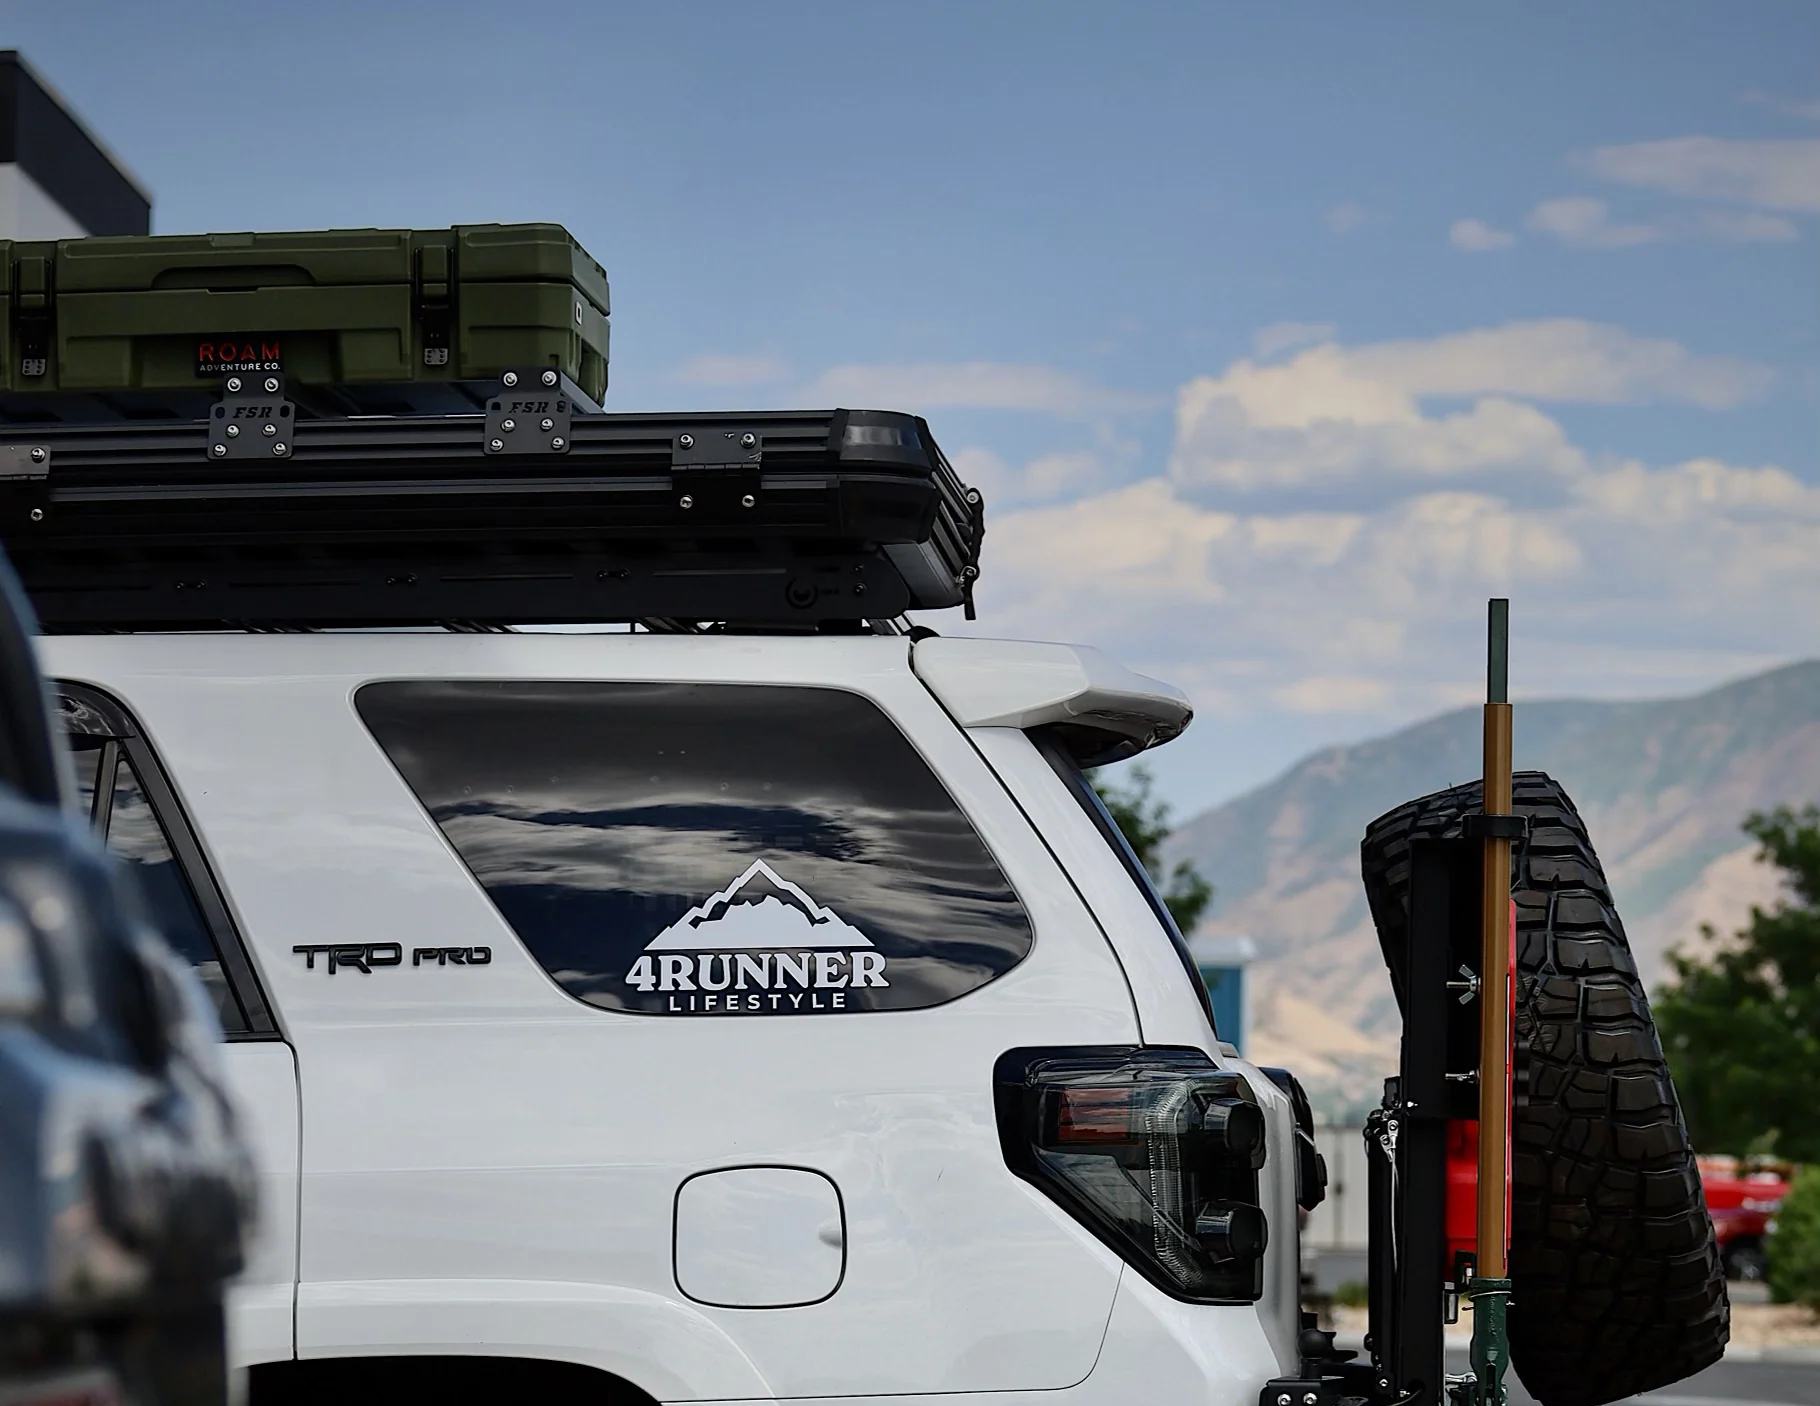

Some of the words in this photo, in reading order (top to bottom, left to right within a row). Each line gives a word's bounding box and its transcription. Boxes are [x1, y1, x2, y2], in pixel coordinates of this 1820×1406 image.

[199, 342, 281, 362] ROAM
[199, 362, 262, 372] ADVENTURE
[263, 362, 281, 371] CO.
[232, 406, 273, 419] FSR
[508, 401, 549, 414] FSR
[292, 942, 403, 975] TRD
[412, 947, 492, 967] PRO
[625, 951, 890, 992] 4RUNNER
[669, 992, 845, 1012] LIFESTYLE
